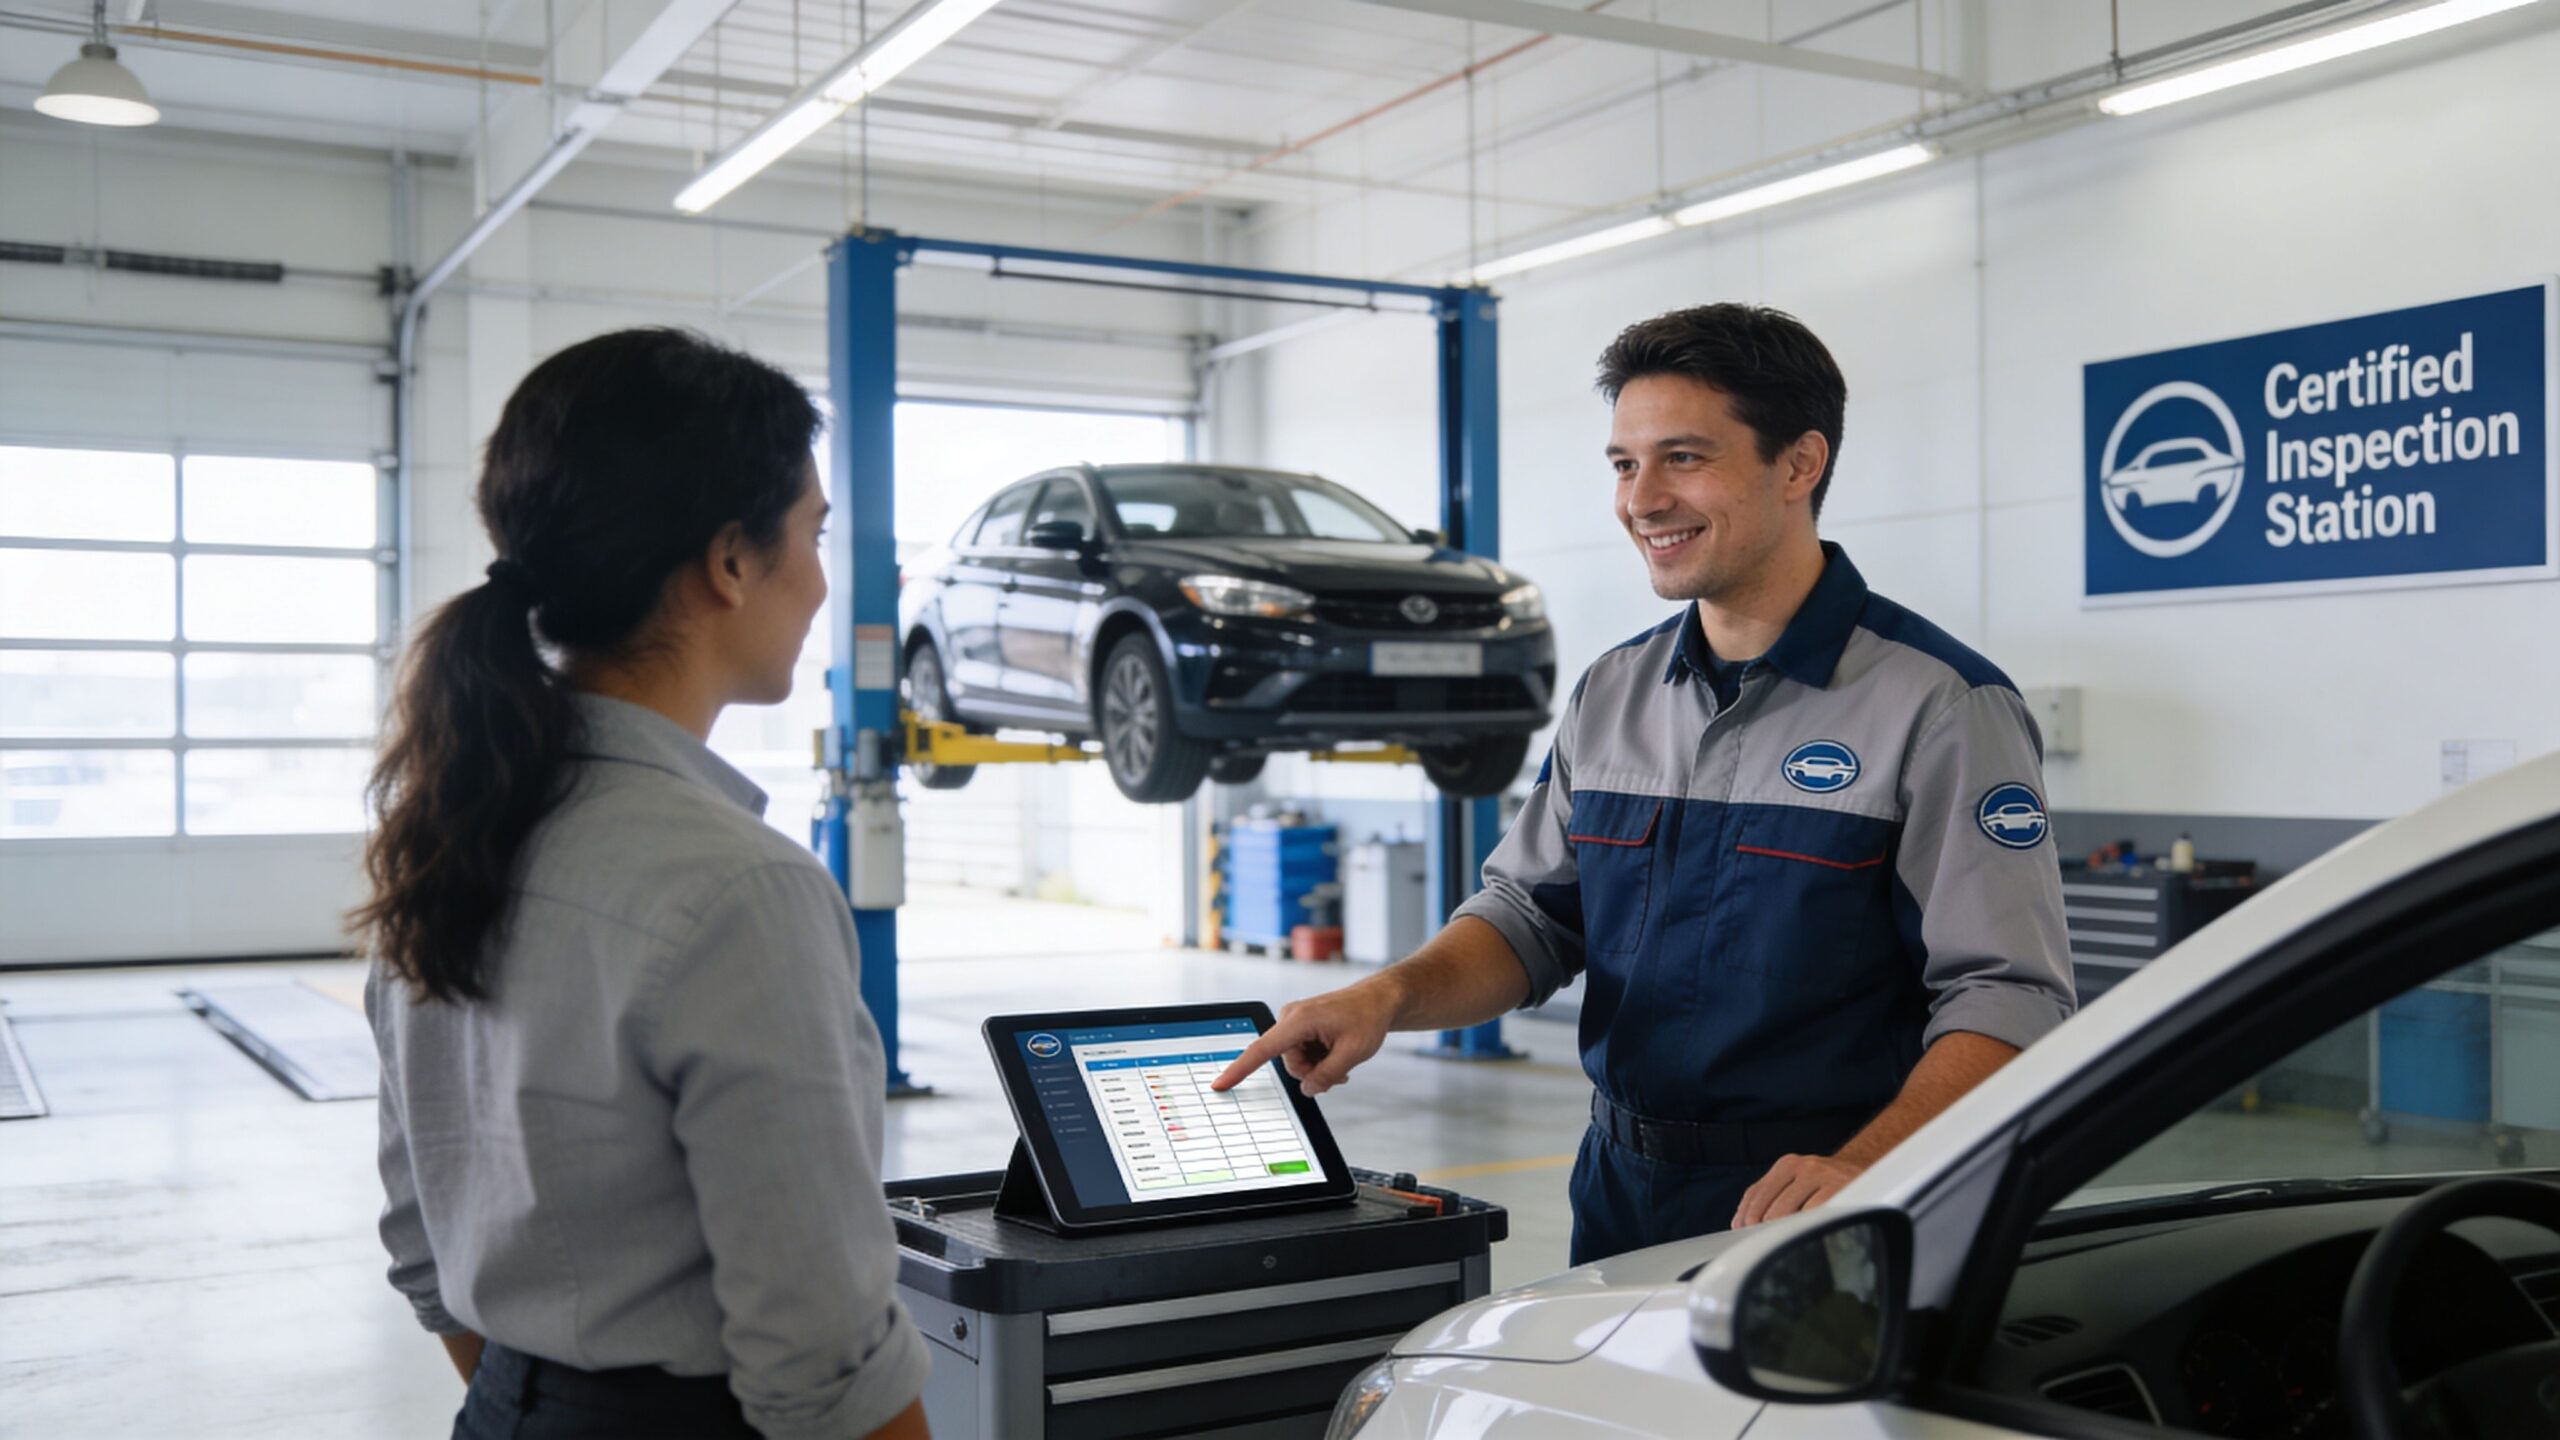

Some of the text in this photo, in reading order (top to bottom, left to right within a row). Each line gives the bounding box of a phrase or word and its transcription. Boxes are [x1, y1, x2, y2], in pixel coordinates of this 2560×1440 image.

[2264, 331, 2473, 419] Certified
[2266, 407, 2520, 488] Inspection
[2265, 484, 2437, 548] Station
